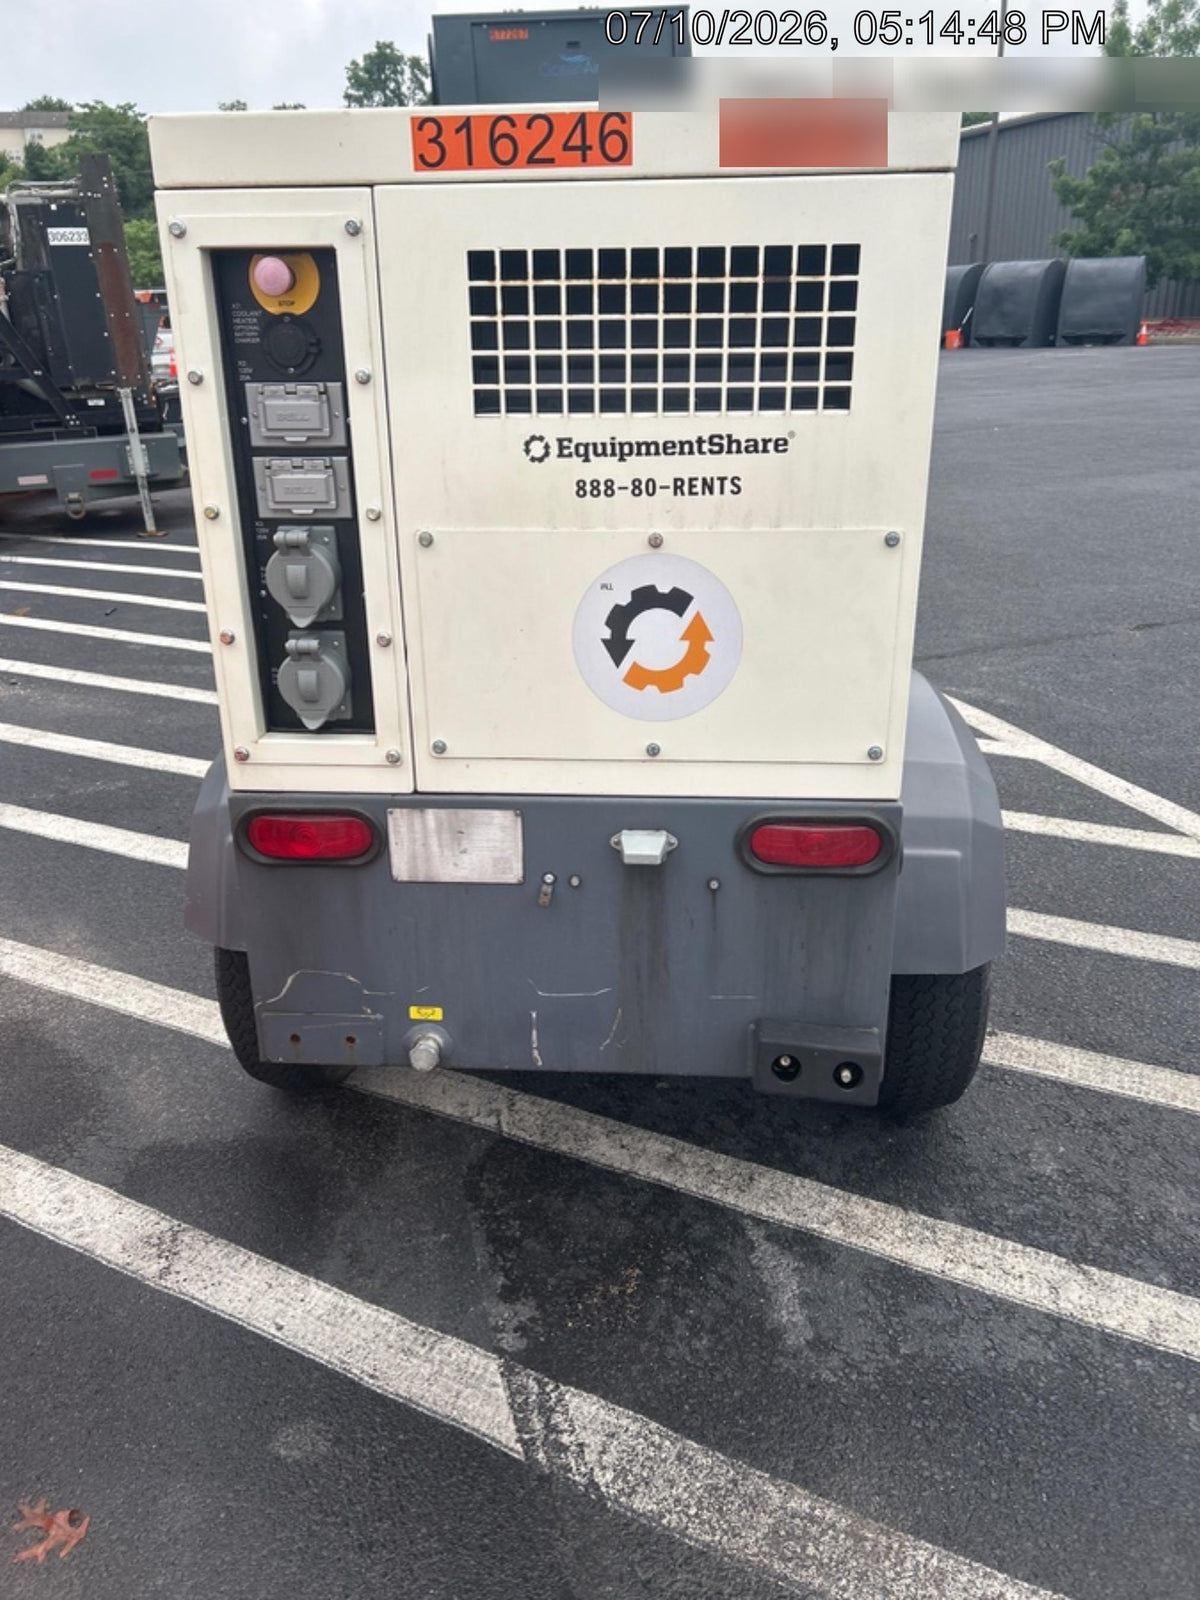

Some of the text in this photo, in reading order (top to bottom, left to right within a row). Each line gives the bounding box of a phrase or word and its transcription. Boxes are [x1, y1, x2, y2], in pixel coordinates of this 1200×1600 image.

[416, 112, 629, 168] 316246
[556, 433, 789, 463] EquipmentShare
[575, 476, 742, 498] 888-80-RENTS
